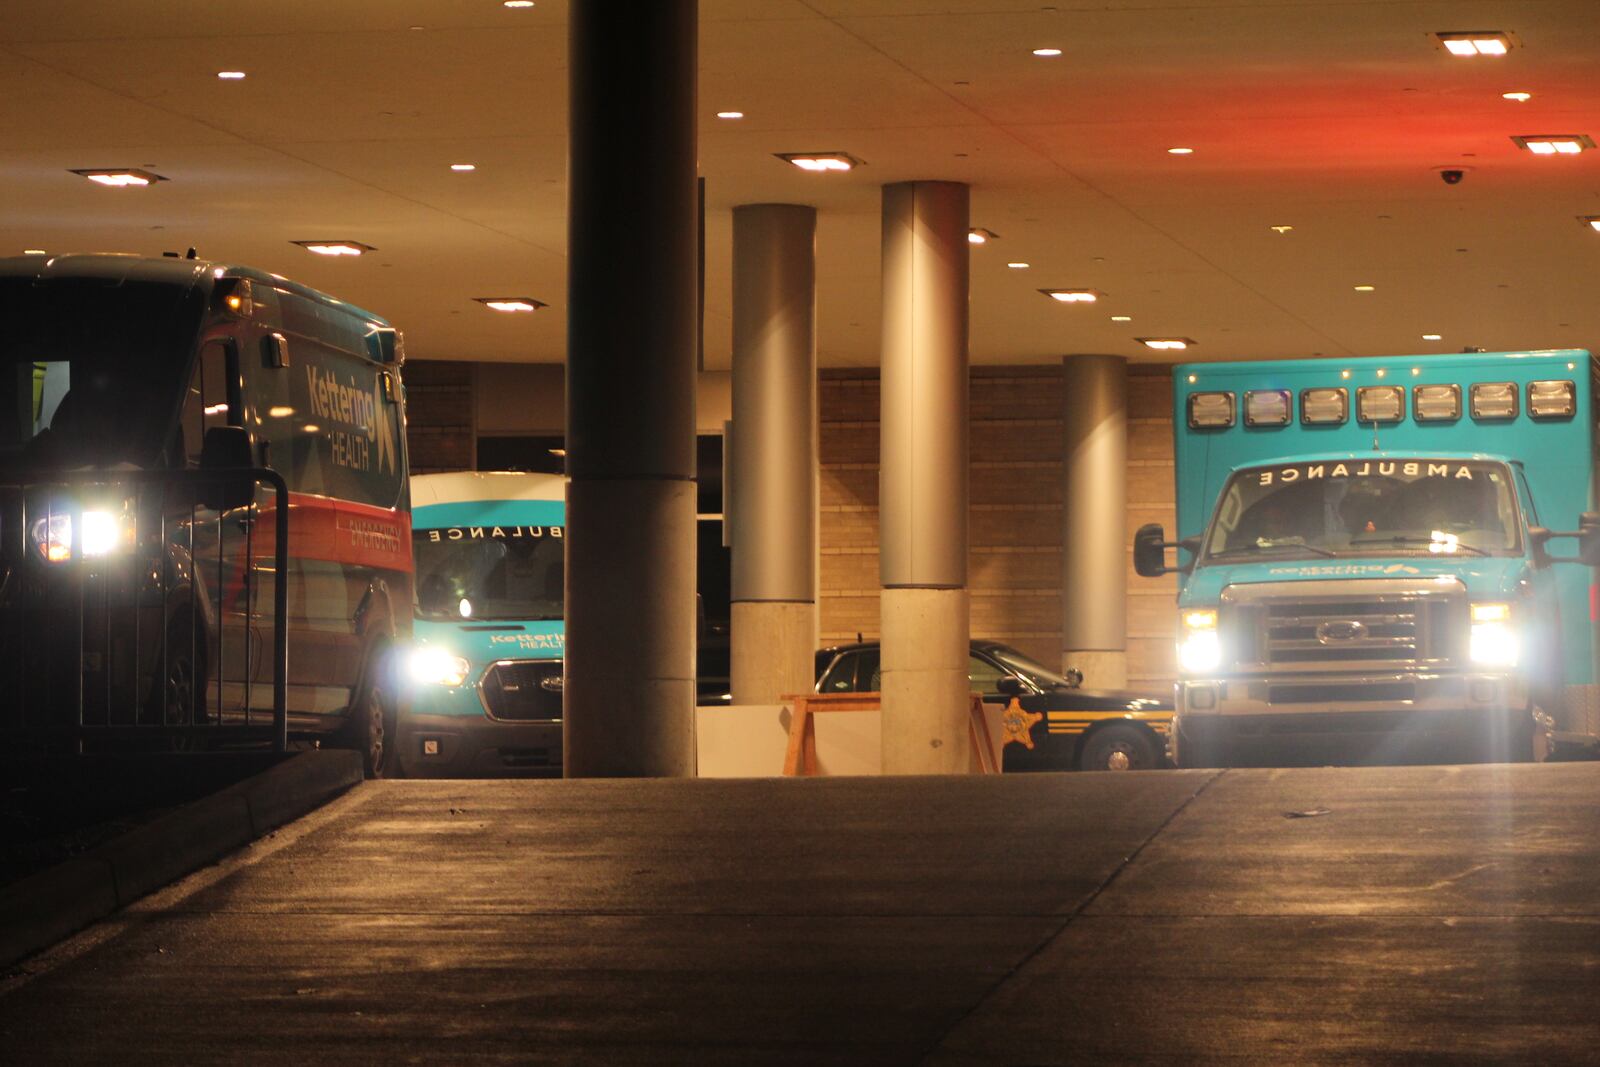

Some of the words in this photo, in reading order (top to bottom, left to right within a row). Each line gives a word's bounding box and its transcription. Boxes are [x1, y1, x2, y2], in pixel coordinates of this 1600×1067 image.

[306, 364, 376, 443] Kettering
[331, 430, 369, 472] HEALTH
[490, 633, 565, 643] Ketteri
